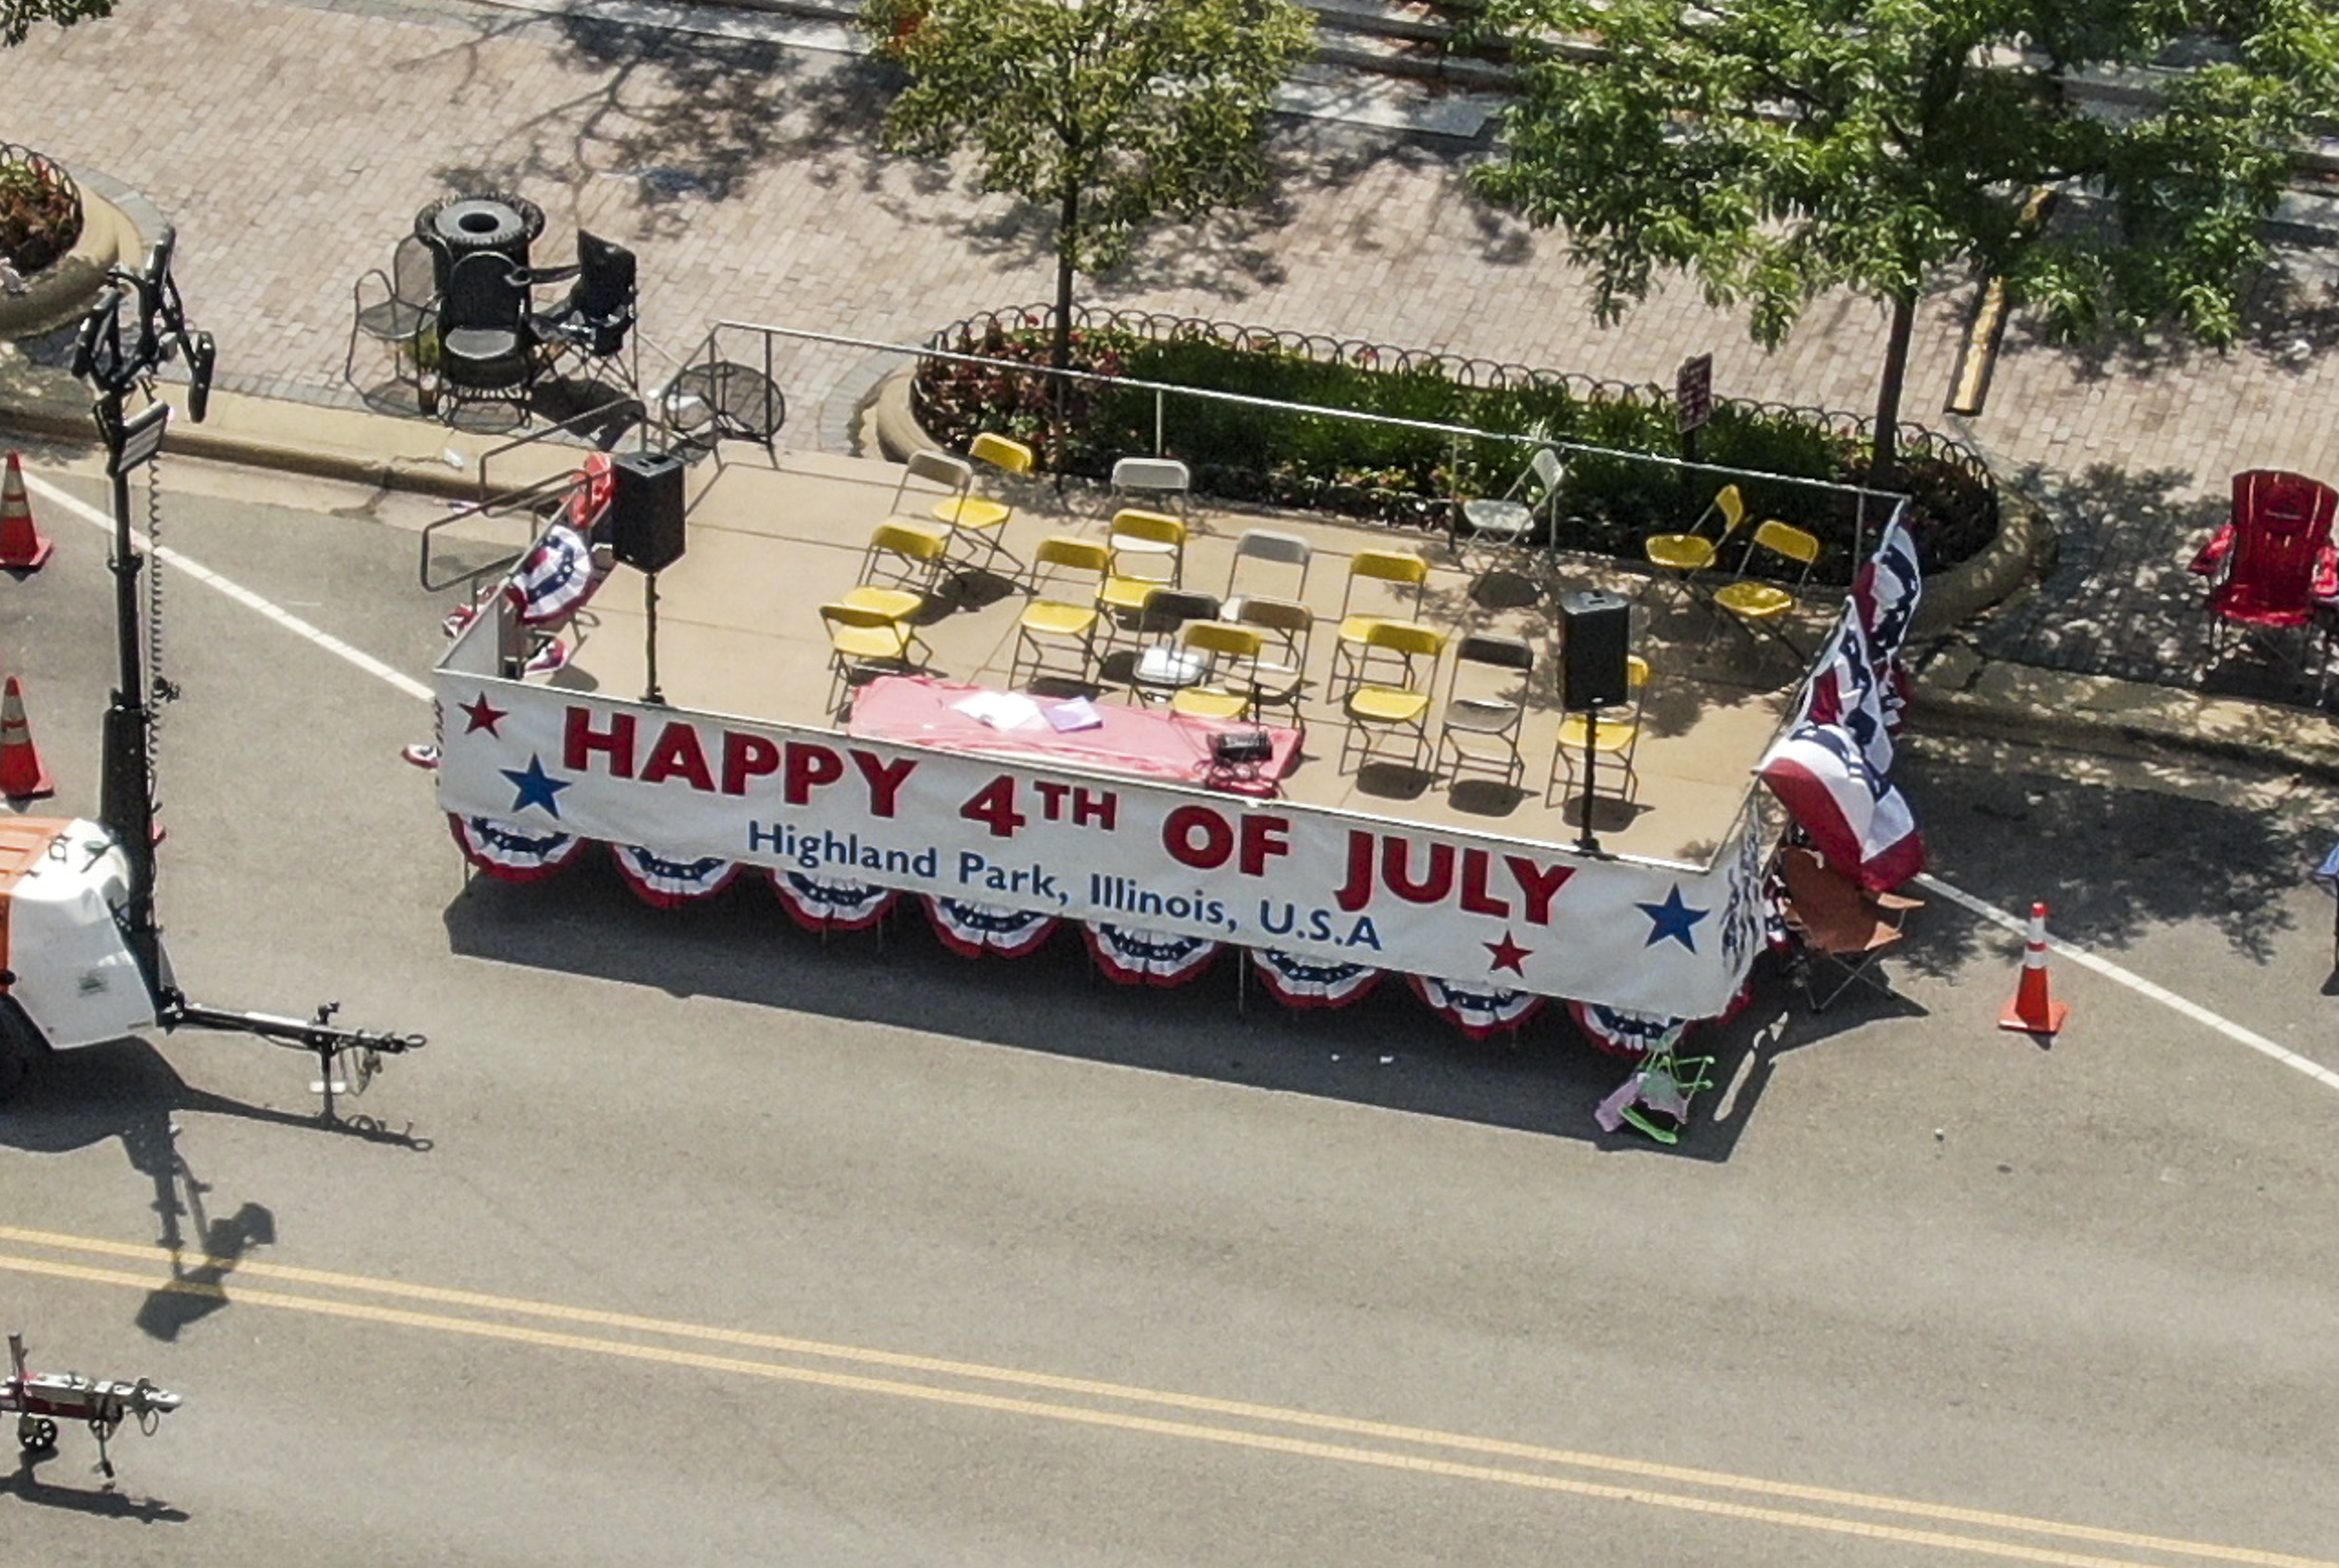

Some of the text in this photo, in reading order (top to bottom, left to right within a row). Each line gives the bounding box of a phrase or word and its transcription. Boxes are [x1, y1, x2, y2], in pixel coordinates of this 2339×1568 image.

[565, 706, 1577, 925] HAPPY 4TH OF JULY
[748, 820, 1382, 951] Highland Park, Illinois, U.S.A
